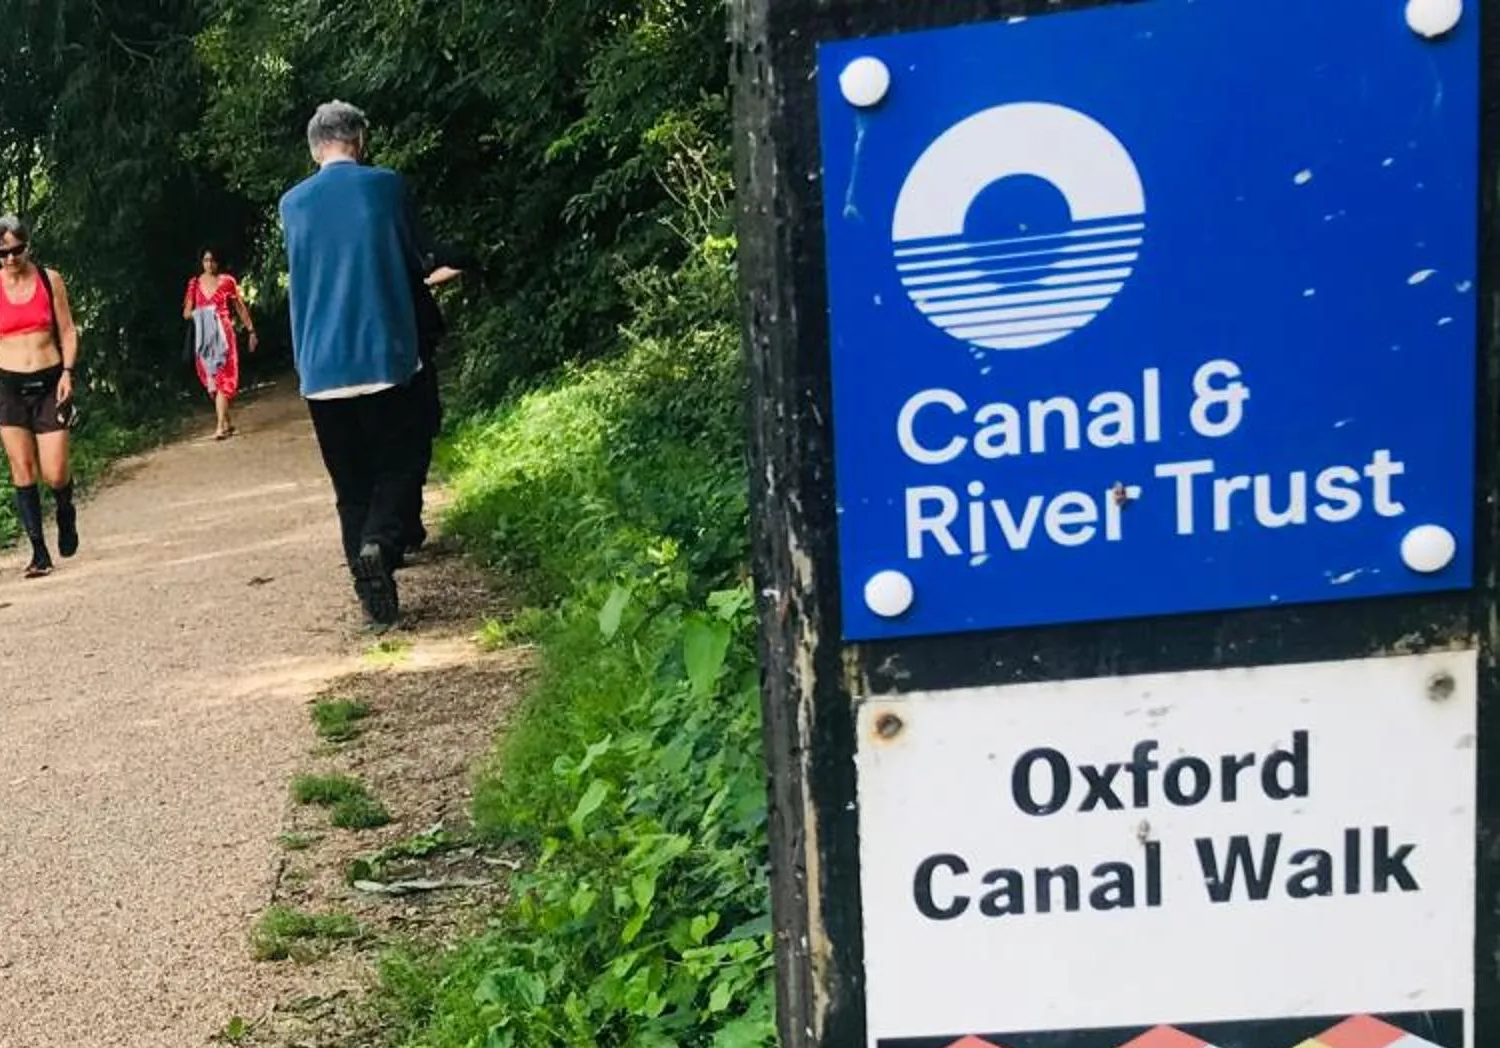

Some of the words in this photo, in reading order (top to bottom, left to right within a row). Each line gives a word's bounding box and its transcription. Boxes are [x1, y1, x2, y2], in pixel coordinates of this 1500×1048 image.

[897, 367, 1162, 465] Canal
[1189, 359, 1250, 438] &
[905, 481, 1142, 559] River
[1154, 449, 1406, 536] Trust
[1011, 730, 1310, 817] Oxford
[912, 840, 1162, 920] Canal
[1195, 825, 1421, 903] Walk
